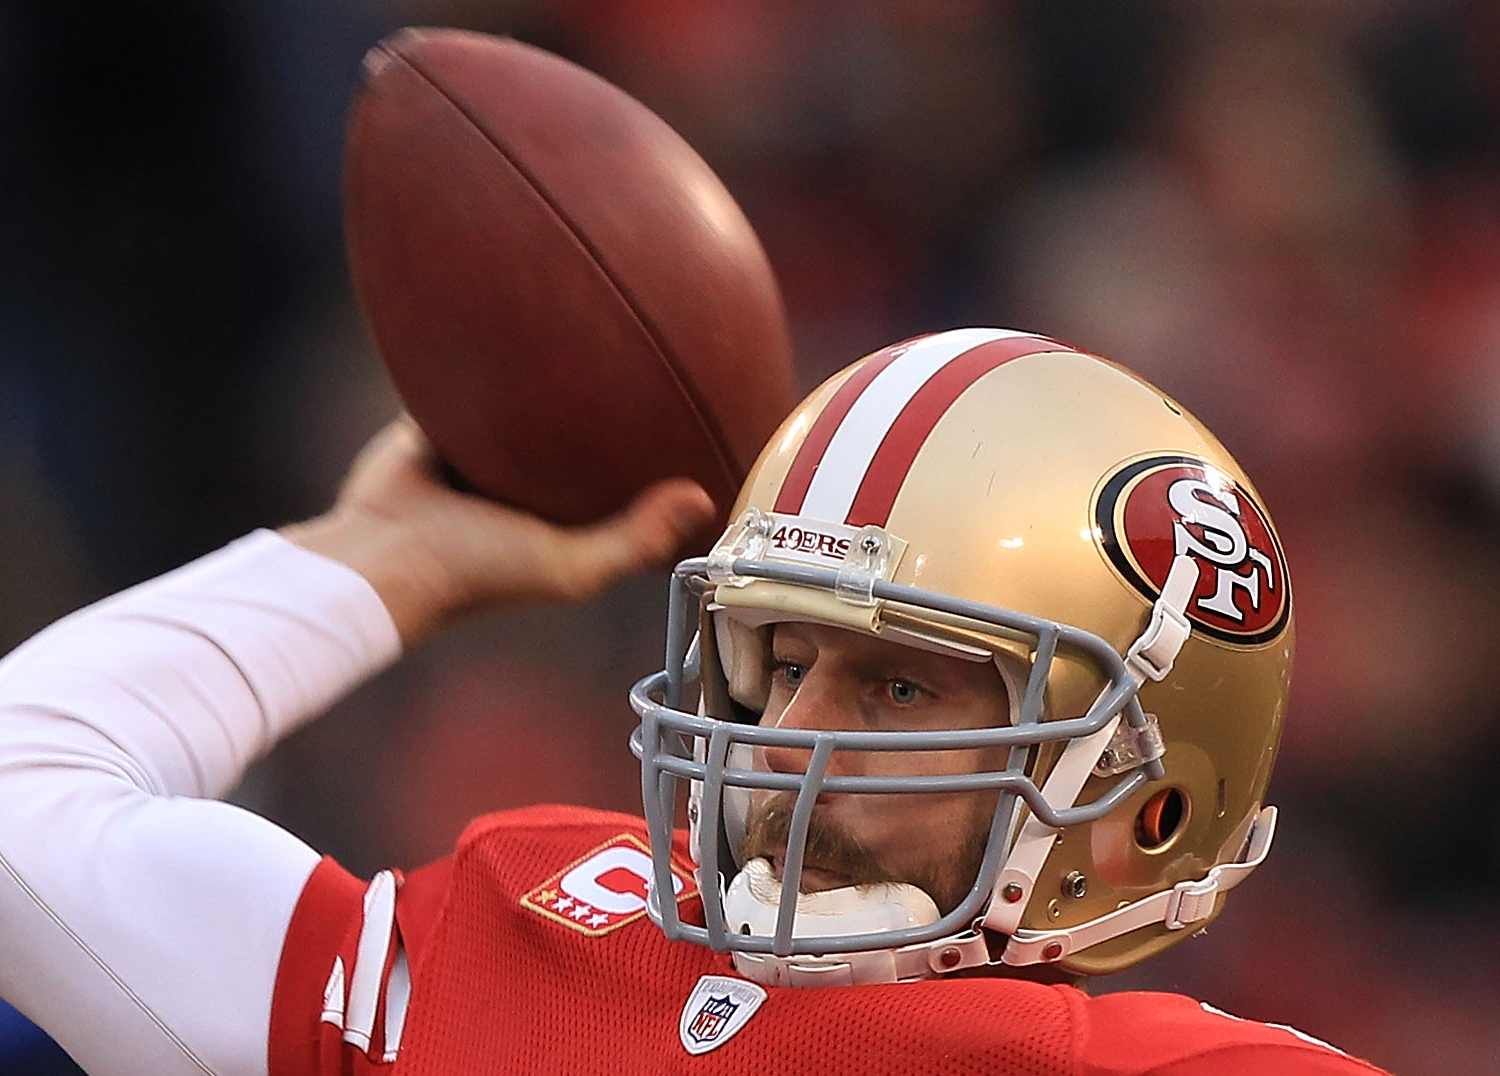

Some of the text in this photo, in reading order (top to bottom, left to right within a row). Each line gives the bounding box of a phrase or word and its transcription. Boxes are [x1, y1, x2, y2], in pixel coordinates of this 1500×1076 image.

[771, 525, 852, 559] 49ERS
[559, 845, 685, 915] C
[690, 1010, 723, 1038] NFL
